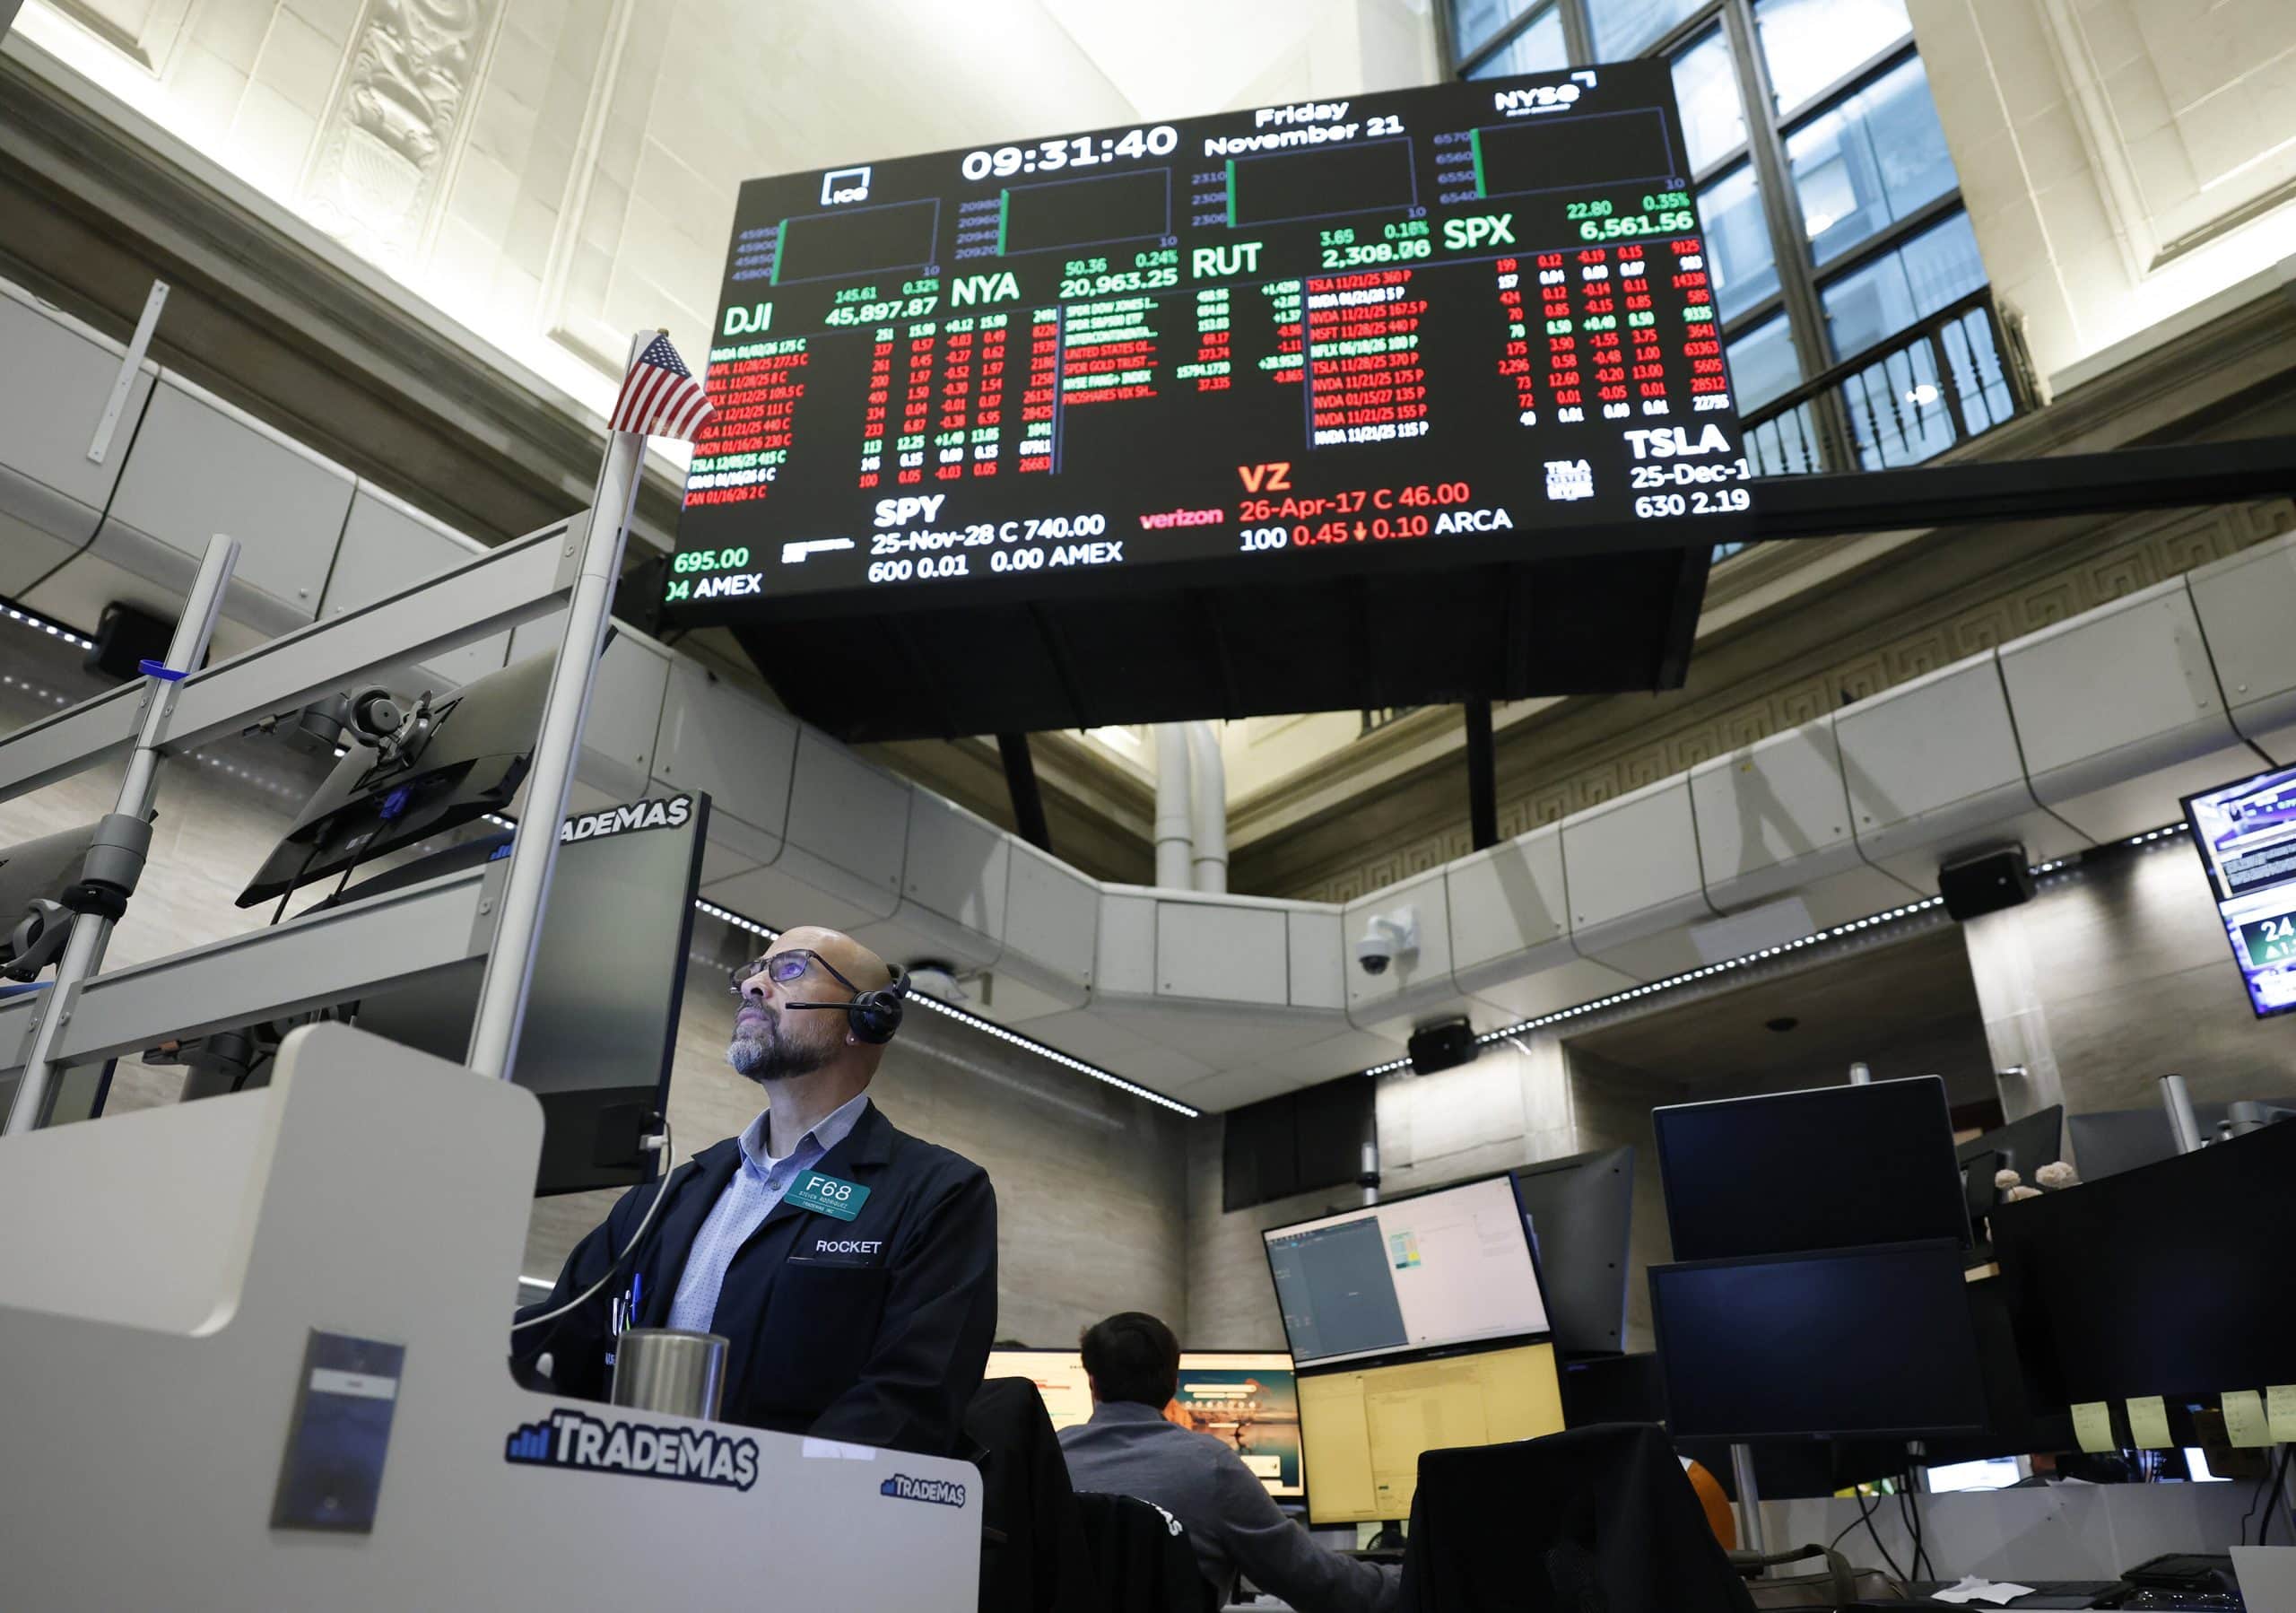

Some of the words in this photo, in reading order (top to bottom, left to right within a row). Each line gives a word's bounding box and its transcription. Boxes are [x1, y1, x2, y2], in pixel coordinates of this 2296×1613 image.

[1255, 101, 1350, 127] Friday
[961, 126, 1178, 180] 09:31:40
[1205, 123, 1359, 157] November
[1366, 115, 1405, 136] 21
[1665, 178, 1685, 190] 10
[1408, 206, 1426, 219] 10
[1567, 199, 1613, 221] 22.80
[1642, 192, 1691, 212] 0.35%
[1160, 236, 1178, 248] 10
[1444, 213, 1516, 249] SPX
[1580, 210, 1694, 241] 6,561.56
[1065, 257, 1108, 276] 50.36
[1135, 249, 1178, 269] 0.24%
[1192, 241, 1263, 279] RUT
[1308, 278, 1335, 292] TSLA
[1335, 273, 1381, 290] 11/21/25
[1402, 269, 1412, 282] P
[1496, 257, 1518, 273] 199
[1537, 253, 1562, 268] 0.12
[1578, 248, 1605, 264] -0.19
[1617, 245, 1643, 260] 0.15
[1671, 239, 1700, 255] 9125
[835, 286, 877, 304] 145.61
[902, 278, 940, 295] 0.32%
[951, 271, 1020, 308] NYA
[1058, 267, 1178, 299] 20,963.25
[1309, 310, 1341, 325] NVDA
[1341, 304, 1387, 322] 11/21/25
[1388, 301, 1419, 317] 167.5
[1418, 301, 1428, 313] P
[1500, 291, 1521, 305] 424
[1542, 286, 1568, 301] 0.12
[1582, 282, 1611, 297] -0.14
[1622, 278, 1648, 292] 0.11
[723, 302, 773, 336] DJI
[824, 296, 938, 328] 45,897.87
[1309, 326, 1339, 341] MSFT
[1409, 318, 1419, 331] P
[1508, 307, 1524, 321] 70
[1585, 298, 1613, 313] -0.15
[1311, 360, 1340, 375] TSLA
[1387, 353, 1410, 368] 370
[1409, 352, 1419, 365] P
[1507, 341, 1527, 356] 175
[1549, 336, 1575, 352] 3.90
[1589, 332, 1619, 348] -1.55
[1632, 328, 1657, 344] 3.75
[1687, 324, 1716, 339] 3641
[1312, 377, 1344, 392] NVDA
[1345, 371, 1392, 389] 11/21/25
[1394, 370, 1415, 385] 175
[1414, 369, 1424, 382] P
[1636, 345, 1661, 362] 1.00
[1683, 340, 1720, 357] 63363
[795, 384, 804, 397] C
[1312, 394, 1345, 409] NVDA
[1344, 388, 1394, 406] 01/15/27
[1395, 387, 1417, 402] 135
[1416, 386, 1426, 399] P
[1516, 375, 1532, 390] 73
[1549, 371, 1580, 388] 12.60
[1595, 367, 1624, 383] -0.20
[1632, 363, 1664, 379] 13.00
[1693, 358, 1723, 374] 5605
[766, 403, 784, 416] 111
[784, 401, 794, 414] C
[1313, 412, 1346, 427] NVDA
[1347, 406, 1395, 424] 11/21/25
[1396, 405, 1418, 420] 155
[1417, 404, 1428, 417] P
[1518, 393, 1534, 408] 72
[1556, 389, 1582, 405] 0.01
[1597, 385, 1628, 400] -0.05
[1639, 381, 1666, 397] 0.01
[1690, 376, 1726, 393] 28512
[863, 440, 883, 455] 113
[1623, 423, 1731, 459] TSLA
[748, 485, 758, 500] 2
[757, 484, 767, 499] C
[859, 474, 879, 488] 100
[1238, 462, 1292, 493] VZ
[1630, 458, 1752, 489] 25-Dec-1
[873, 493, 945, 528] SPY
[1140, 507, 1224, 530] verizon
[1239, 491, 1366, 523] 26-Apr-17
[1372, 488, 1392, 510] C
[1398, 482, 1471, 508] 46.00
[1635, 493, 1686, 519] 630
[1691, 489, 1751, 514] 2.19
[871, 524, 994, 554] 25-Nov-28
[999, 521, 1019, 542] C
[1022, 513, 1106, 541] 740.00
[1239, 527, 1288, 552] 100
[1292, 522, 1349, 547] 0.45
[1371, 515, 1430, 541] 0.10
[1433, 507, 1514, 536] ARCA
[674, 546, 750, 573] 695.00
[867, 558, 912, 584] 600
[917, 554, 970, 580] 0.01
[990, 547, 1045, 573] 0.00
[1048, 540, 1124, 569] AMEX
[692, 572, 763, 598] AMEX
[560, 798, 690, 841] ADEMAS
[805, 1176, 852, 1200] F68
[816, 1240, 883, 1254] ROCKET
